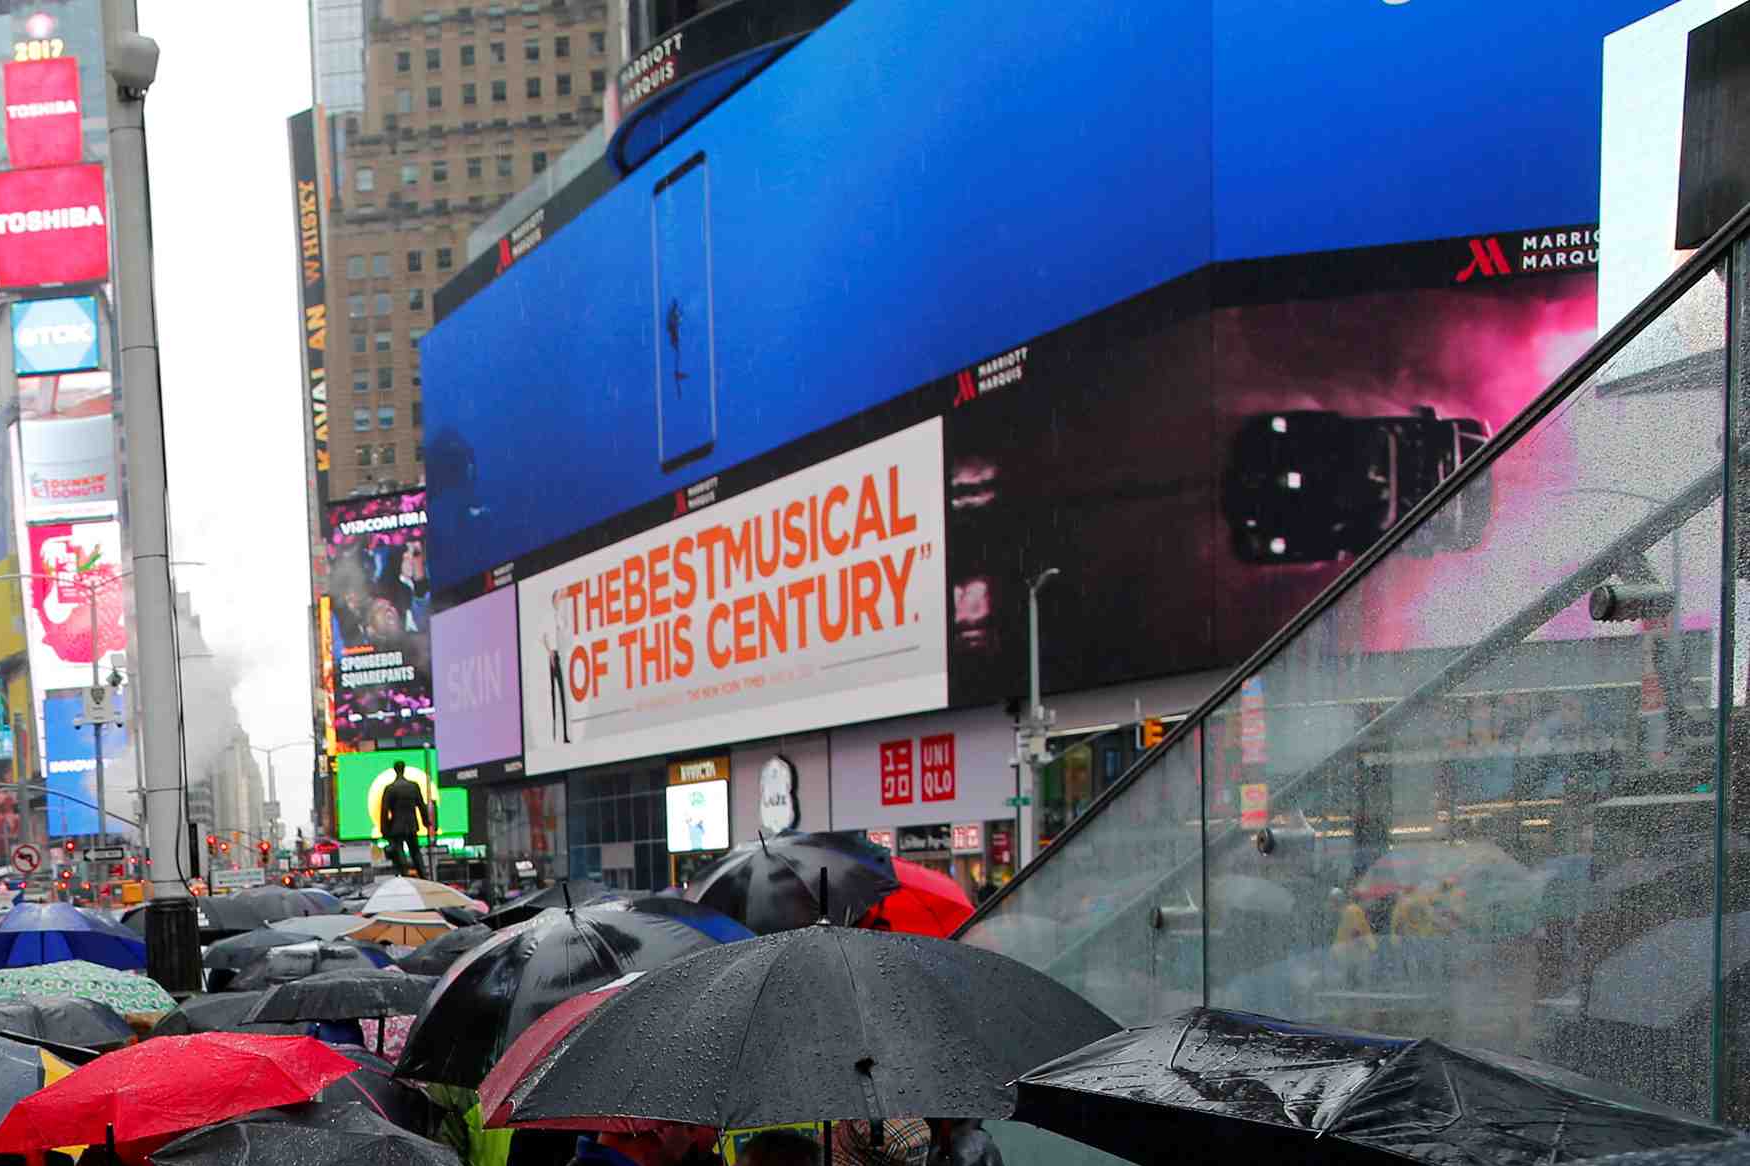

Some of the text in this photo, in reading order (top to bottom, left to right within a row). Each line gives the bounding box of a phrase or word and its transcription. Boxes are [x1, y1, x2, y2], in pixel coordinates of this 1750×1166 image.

[13, 38, 65, 61] 2017
[620, 32, 683, 84] MARRIOTT
[621, 61, 676, 108] MARQUIS
[6, 99, 78, 120] TOSHIBA
[298, 179, 323, 286] WHISKY
[978, 346, 1029, 378] MARRIOTT
[978, 365, 1023, 394] MARQUIS
[50, 485, 107, 499] DONUTS
[340, 516, 398, 536] VIACOM
[623, 523, 727, 625] BEST
[721, 464, 917, 589] MUSICAL
[340, 650, 403, 672] SPONGEBOB
[569, 638, 609, 703] OF
[618, 613, 695, 690] THIS
[340, 666, 415, 688] SQUAREPANTS
[447, 648, 502, 713] SKIN
[923, 743, 950, 767] UNI
[923, 769, 953, 798] QLO
